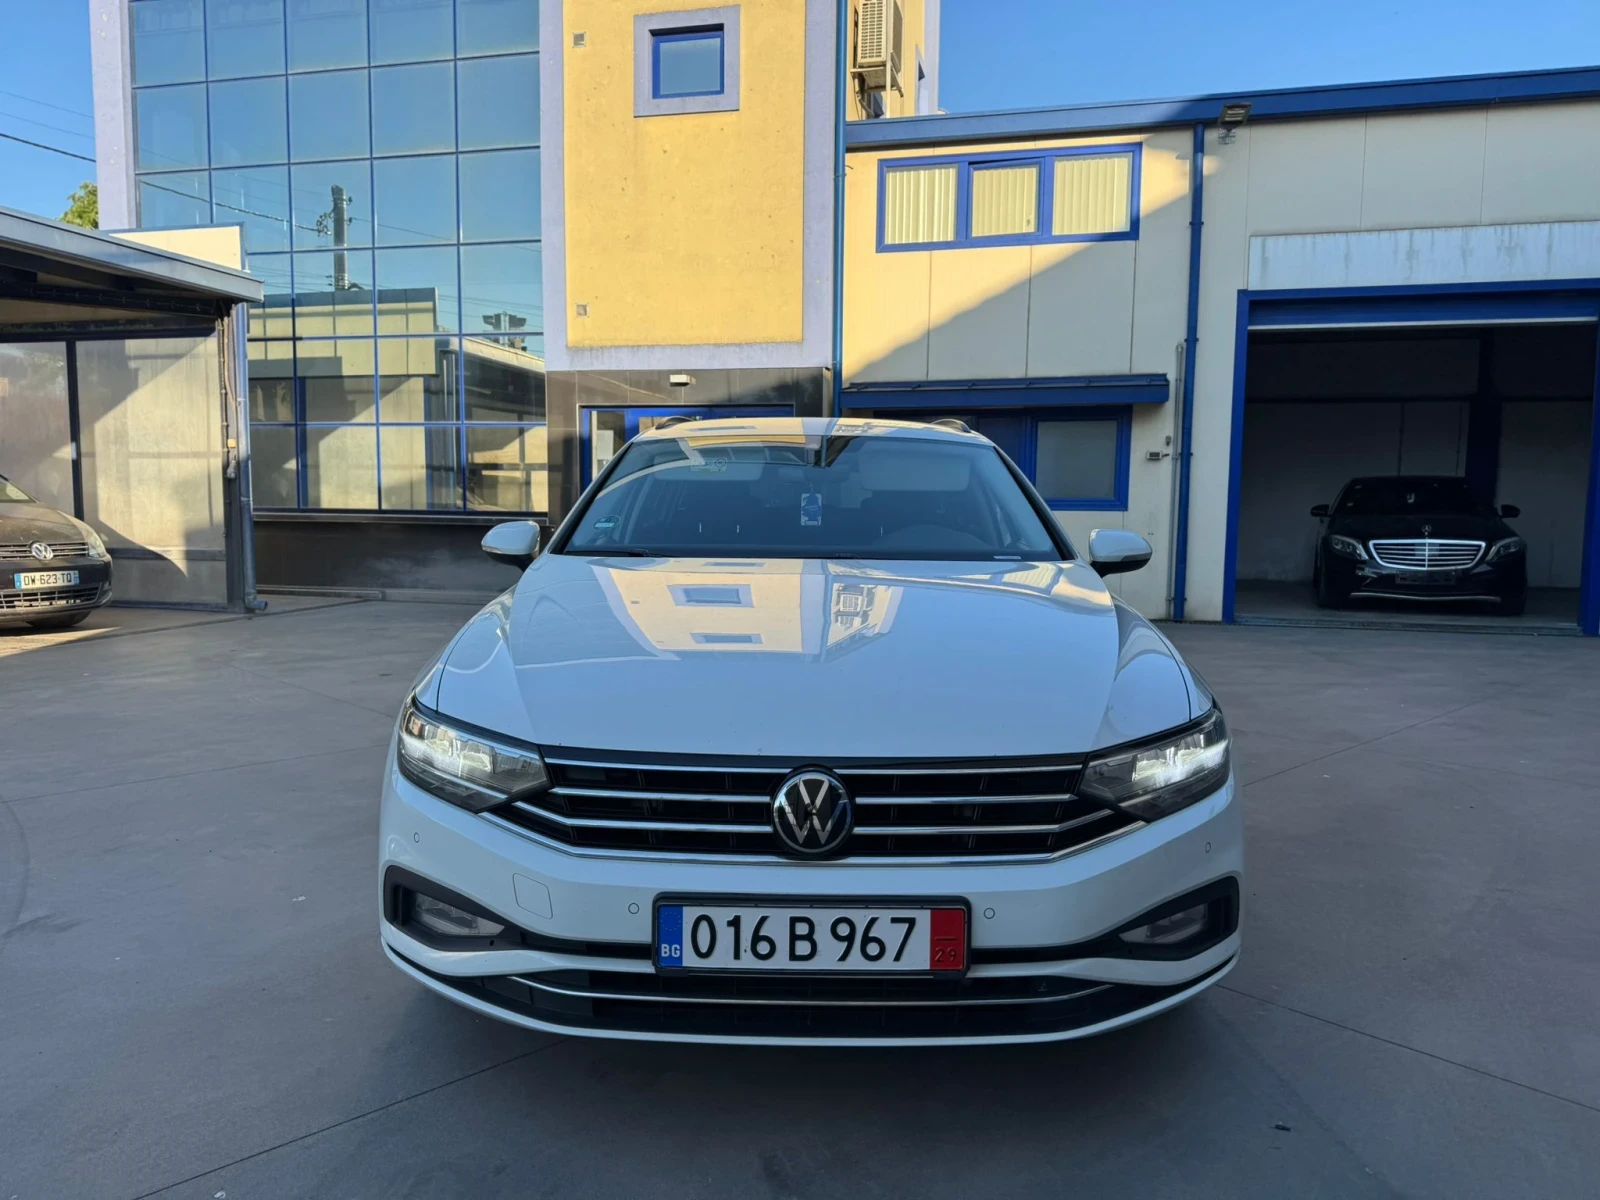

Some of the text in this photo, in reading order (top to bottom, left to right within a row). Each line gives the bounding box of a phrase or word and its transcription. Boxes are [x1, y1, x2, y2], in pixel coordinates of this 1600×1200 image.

[778, 776, 849, 846] VW
[660, 943, 681, 958] BG
[934, 946, 957, 963] 29
